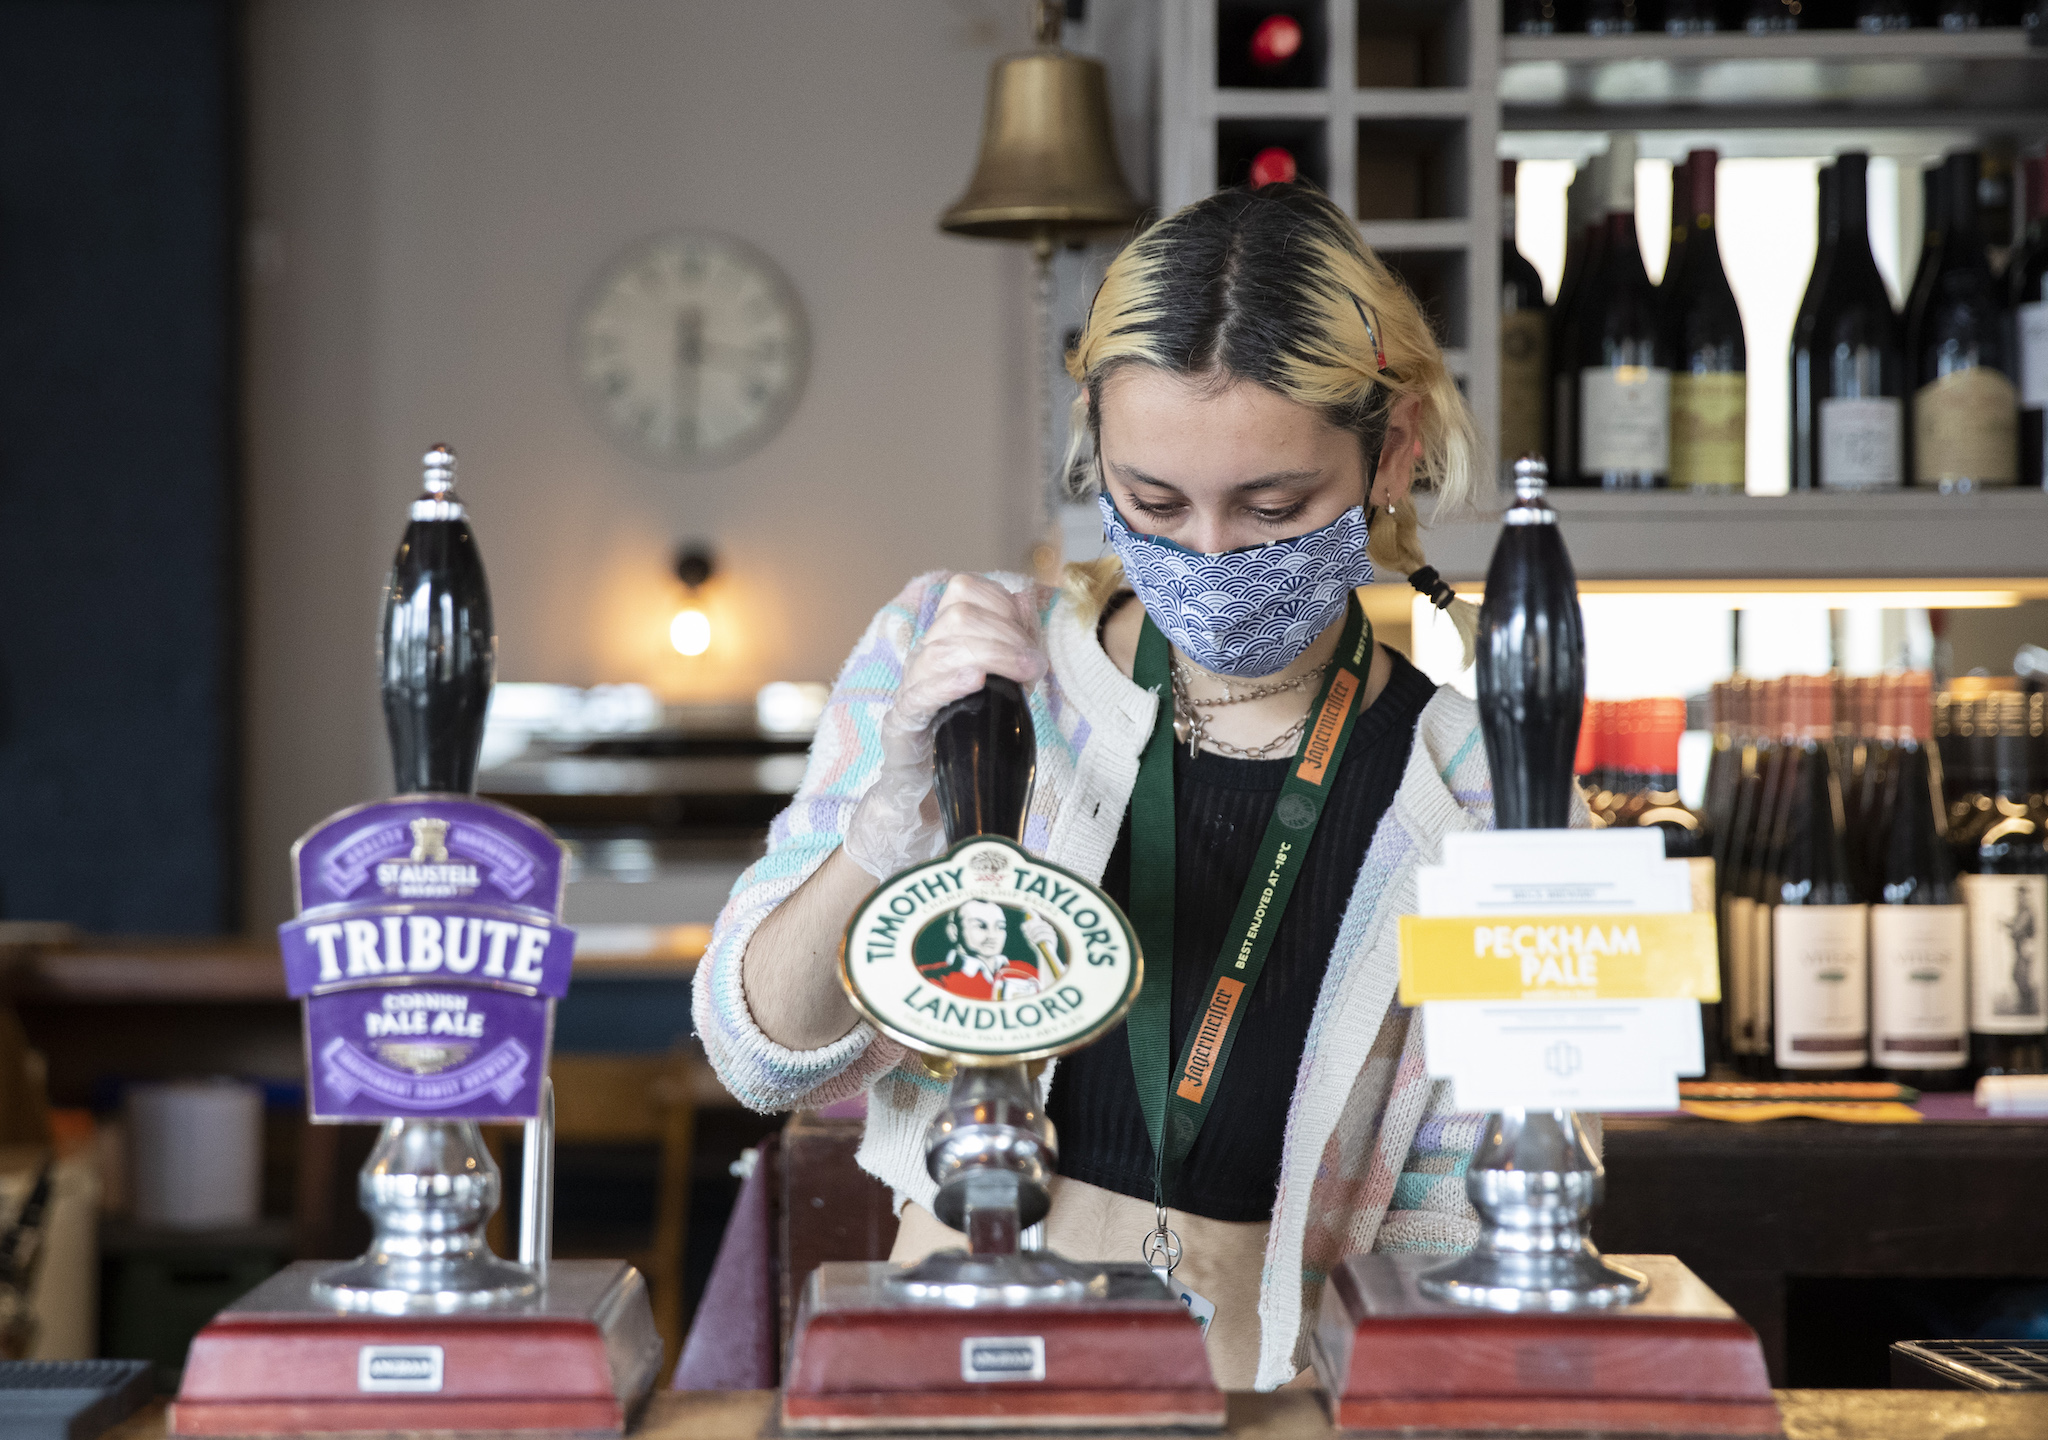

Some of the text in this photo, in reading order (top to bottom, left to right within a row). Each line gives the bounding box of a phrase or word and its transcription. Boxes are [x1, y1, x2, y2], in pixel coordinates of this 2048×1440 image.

[401, 864, 481, 888] AUSTELL
[866, 867, 1121, 969] TIMOTHY TAYLOR'S
[1235, 841, 1292, 969] BEST ENJOYED AT -18°C
[305, 915, 551, 985] TRIBUTE
[1474, 924, 1641, 958] PECKHAM
[1520, 955, 1599, 986] PALE
[382, 992, 469, 1012] CORNISH
[903, 985, 1084, 1030] LANDLORD
[365, 1011, 486, 1038] PALE ALE
